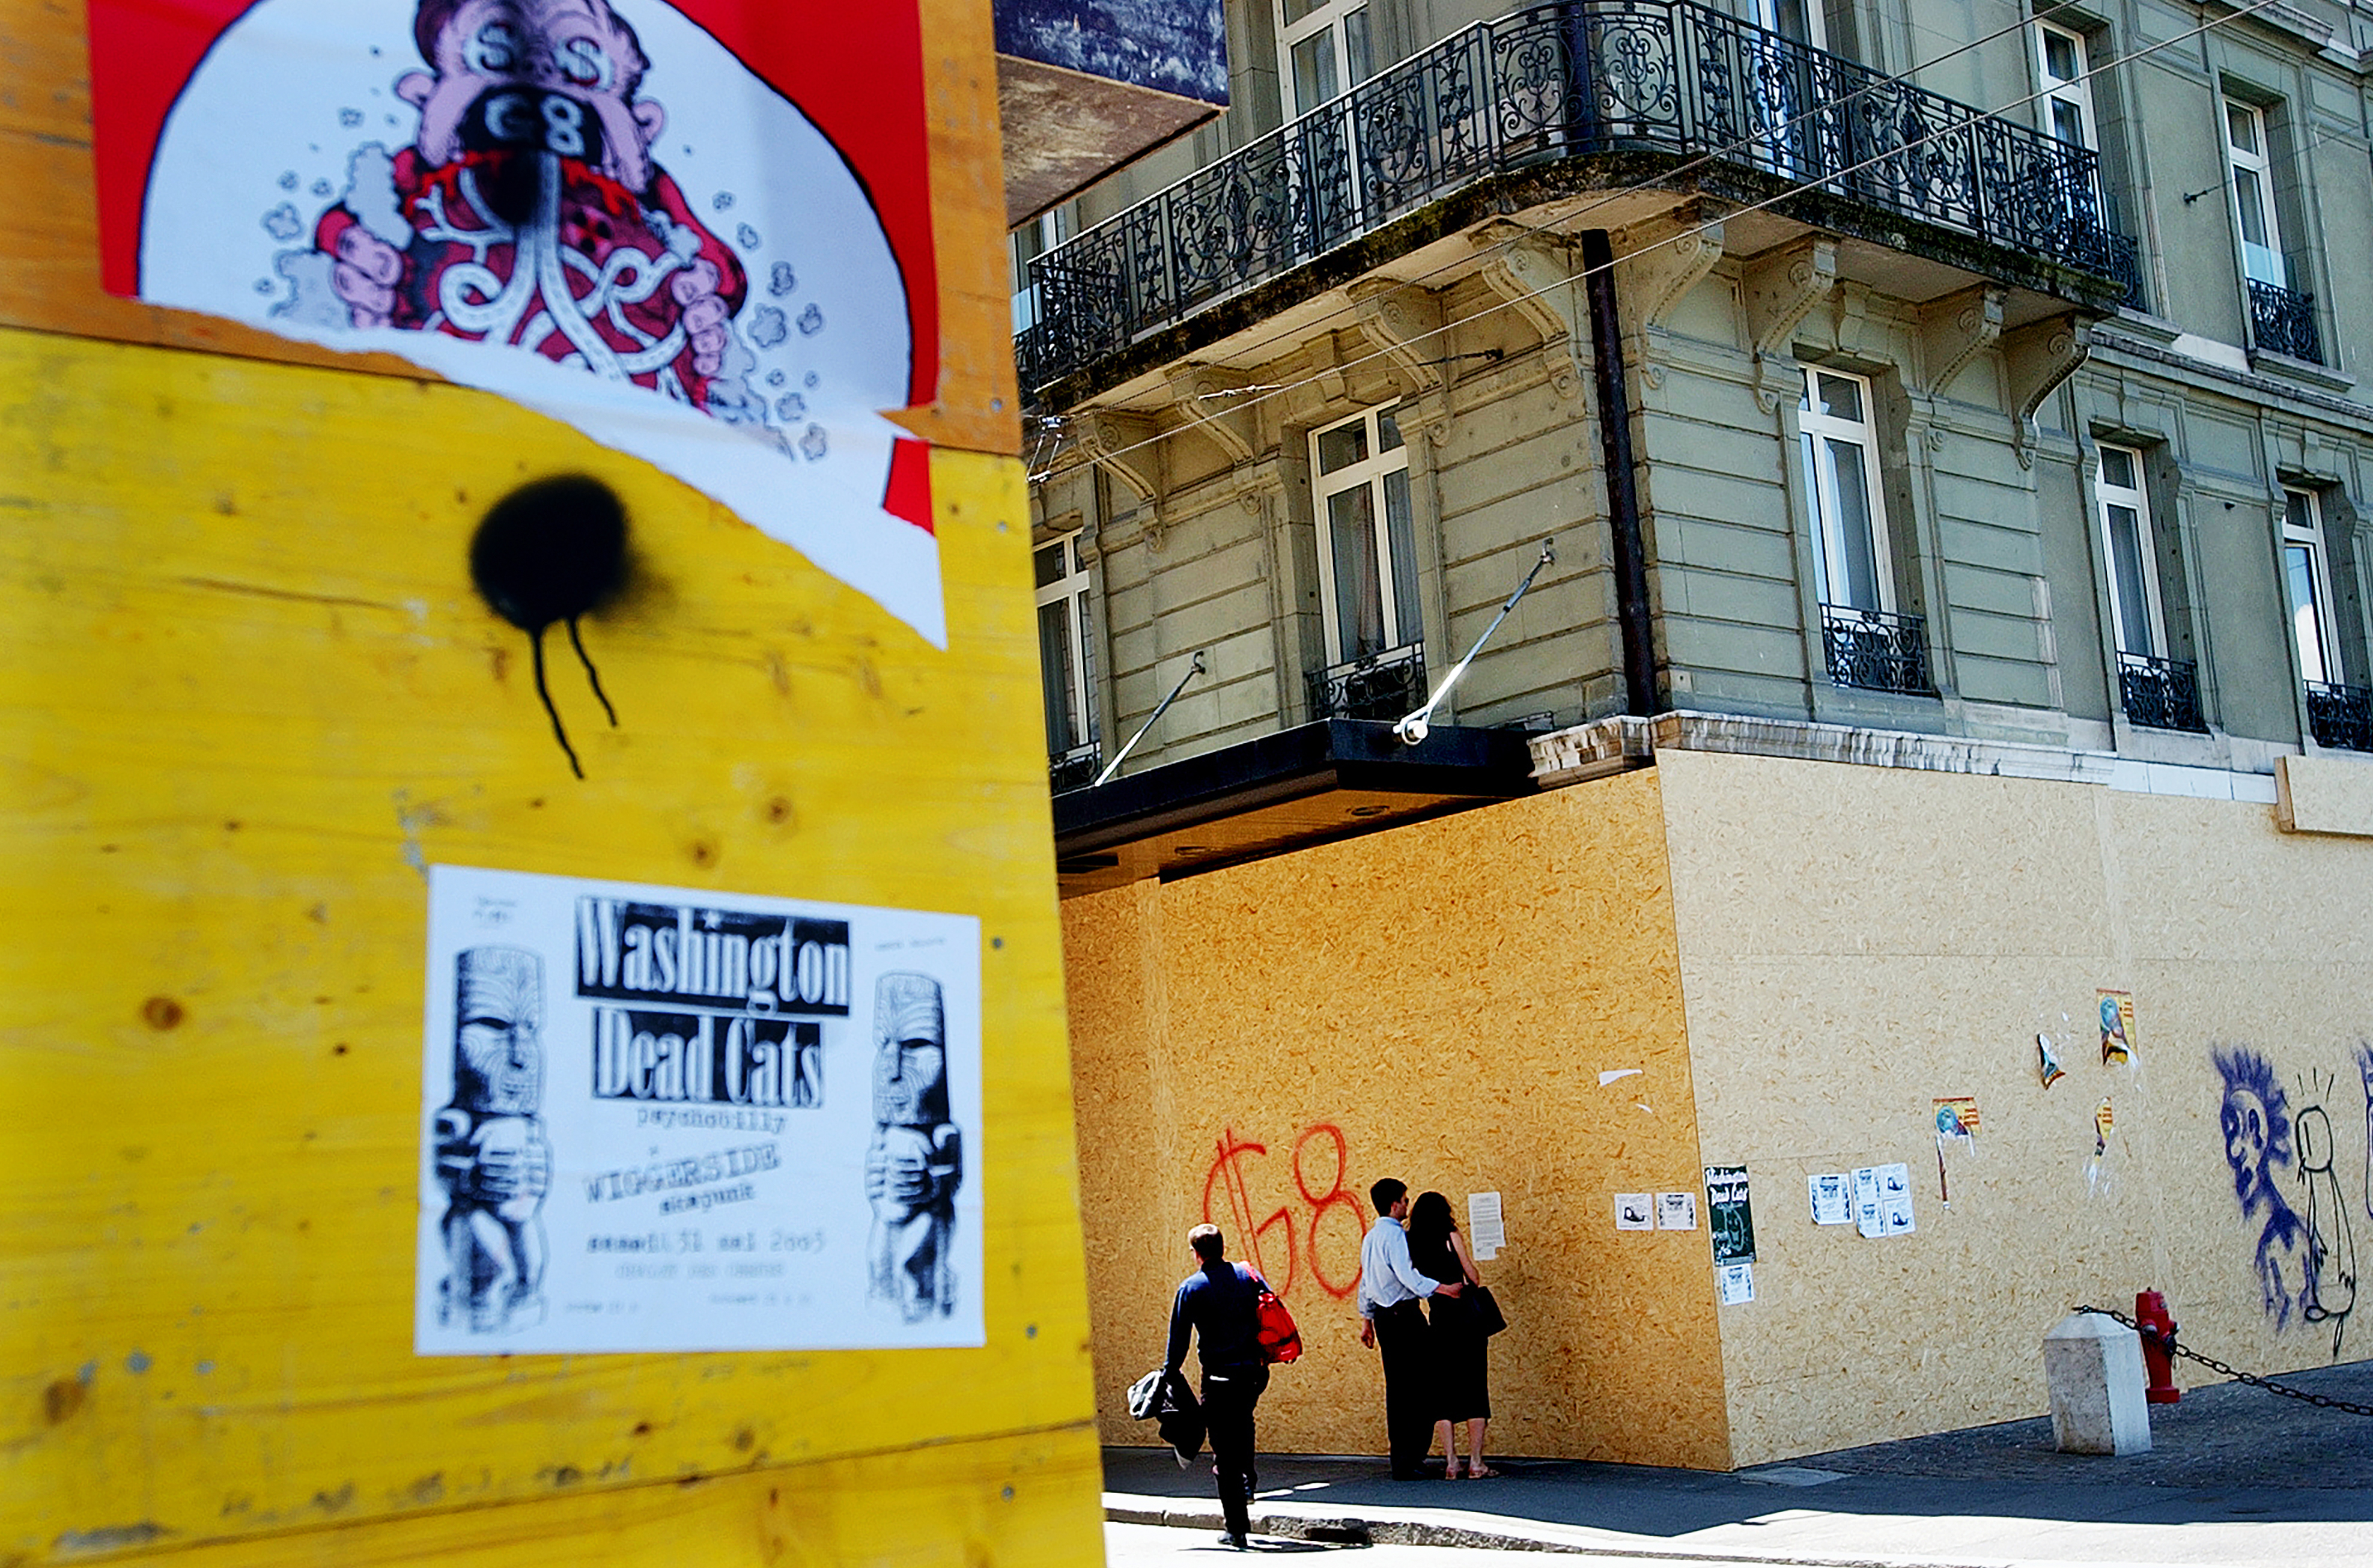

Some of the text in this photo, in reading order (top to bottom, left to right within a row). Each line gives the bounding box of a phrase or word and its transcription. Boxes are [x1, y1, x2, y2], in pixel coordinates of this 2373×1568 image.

[574, 897, 849, 1016] Washington
[596, 1007, 822, 1108] Dead Cats
